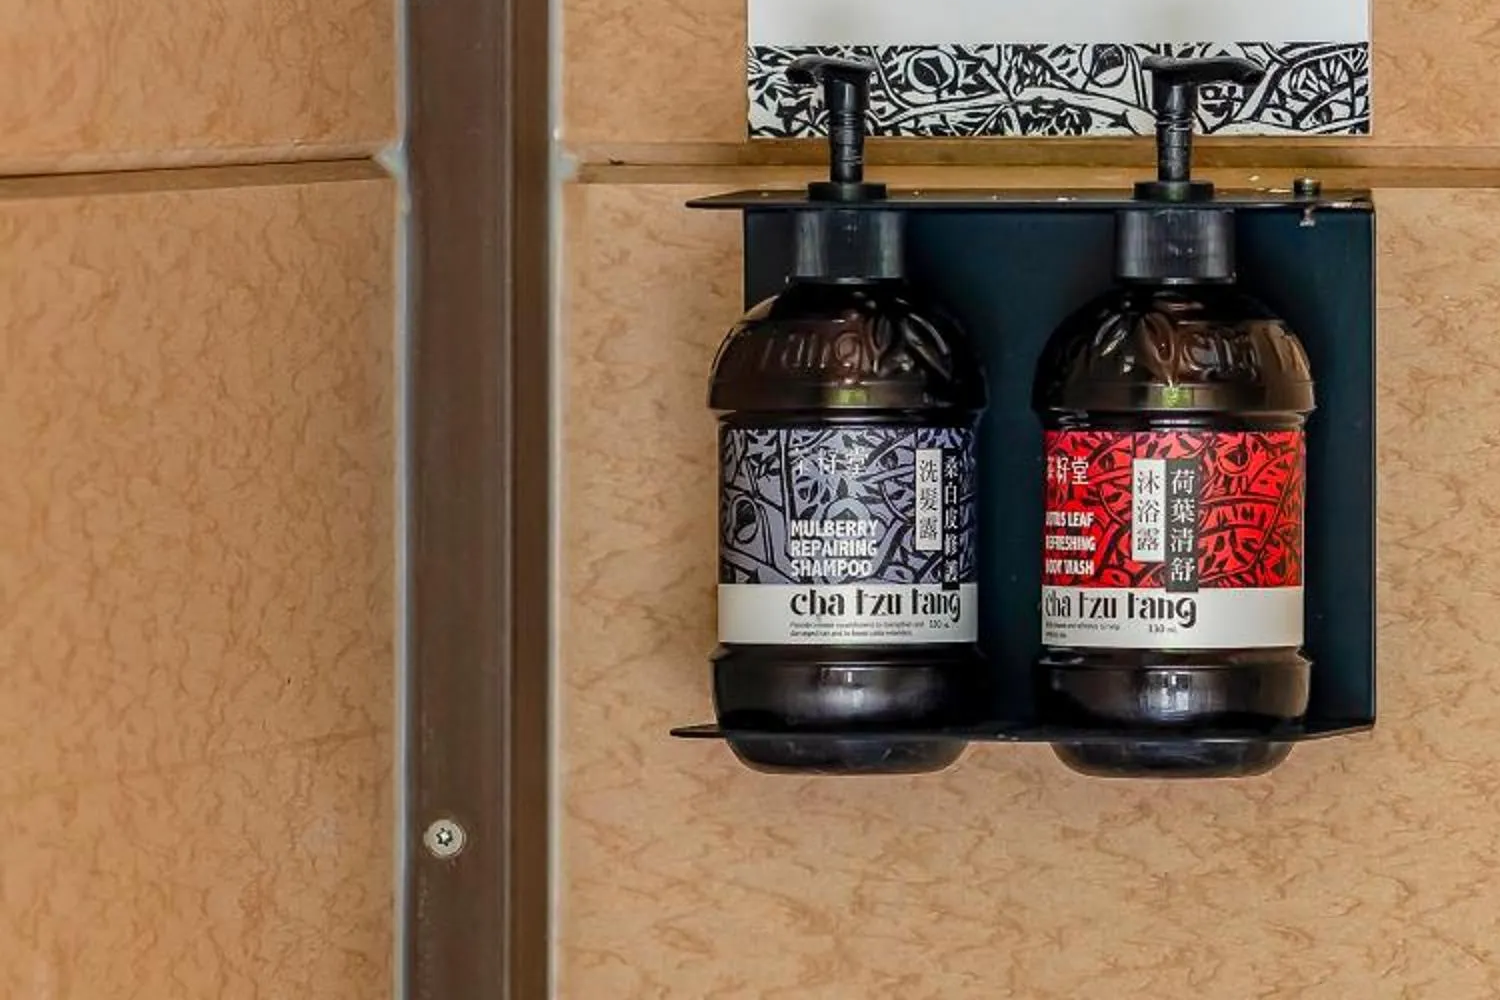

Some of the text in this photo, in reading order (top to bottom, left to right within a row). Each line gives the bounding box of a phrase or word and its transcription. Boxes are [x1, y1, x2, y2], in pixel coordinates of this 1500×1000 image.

[919, 459, 938, 541] 洗髮露
[1137, 469, 1160, 551] 沐浴露
[791, 519, 879, 537] MULBERRY
[1068, 512, 1095, 528] LEAF
[1170, 468, 1195, 582] 荷葉清舒
[791, 539, 878, 557] REPAIRING
[791, 559, 873, 577] SHAMPOO
[1064, 560, 1095, 576] WASH
[790, 588, 961, 623] cha tzu tang
[1045, 591, 1197, 628] cha tzu tang
